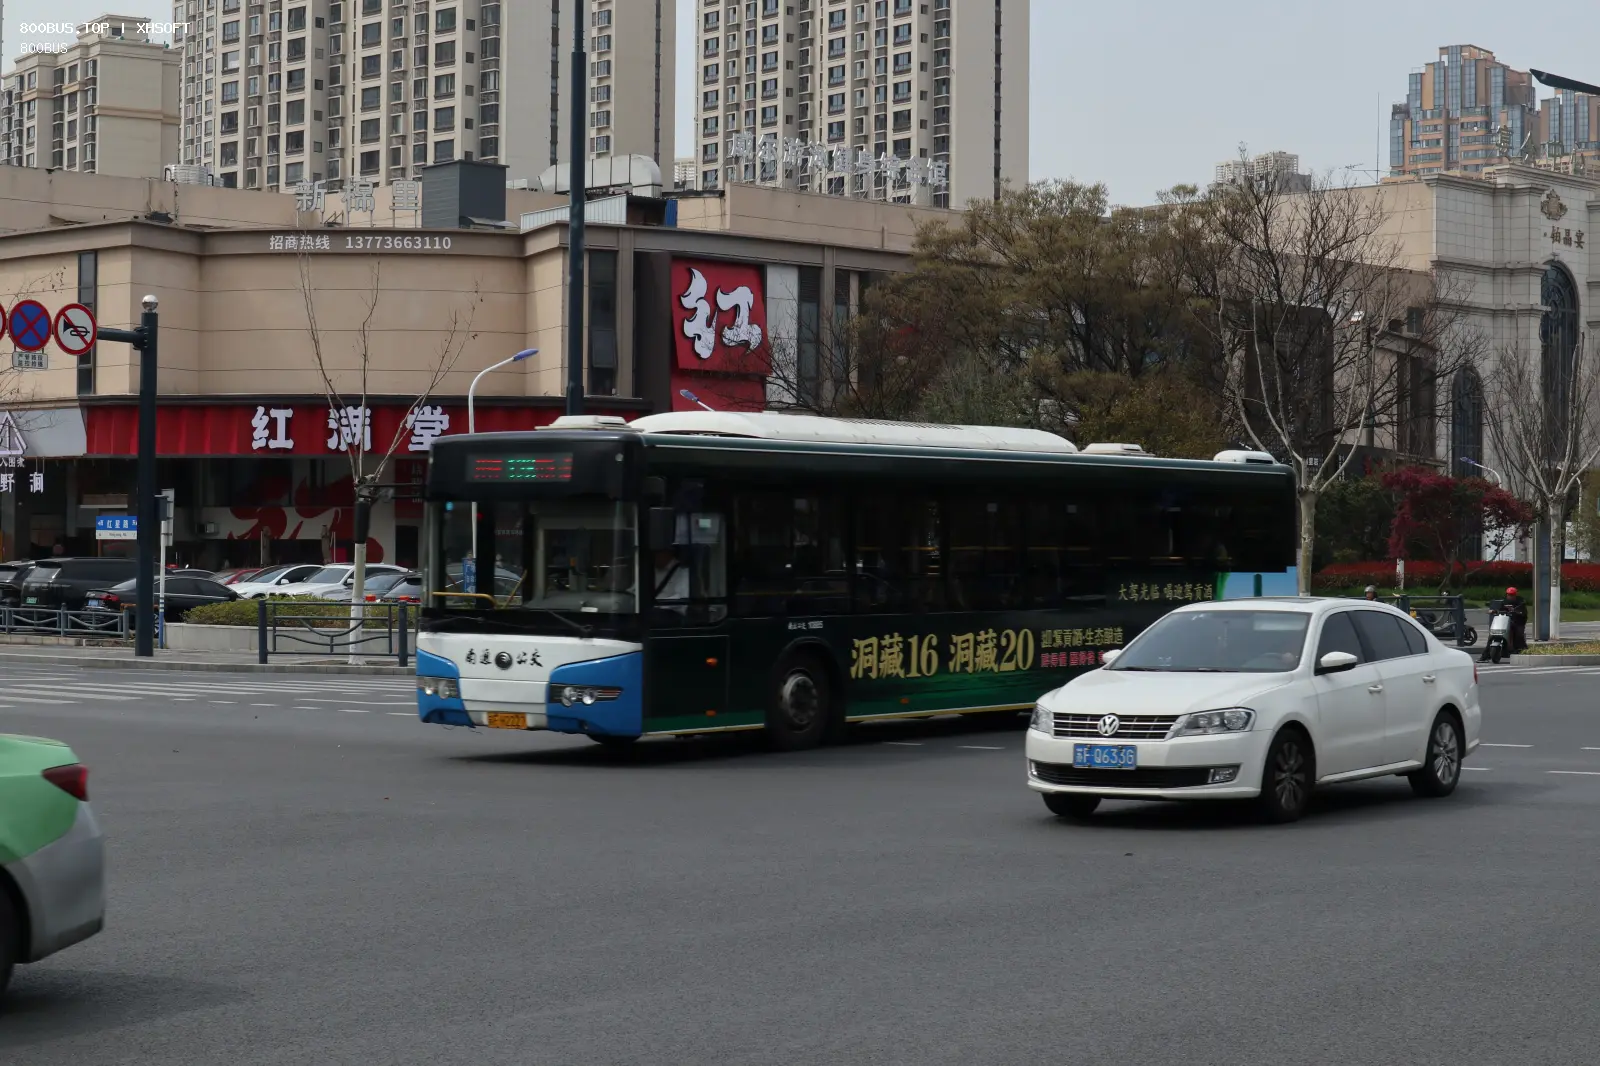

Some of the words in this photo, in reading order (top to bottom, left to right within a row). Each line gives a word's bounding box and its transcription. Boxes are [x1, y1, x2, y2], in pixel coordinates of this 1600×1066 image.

[269, 234, 331, 250] 招商热线
[345, 236, 452, 250] 13773663110
[850, 632, 939, 680] 洞藏16
[949, 627, 1035, 675] 洞藏20
